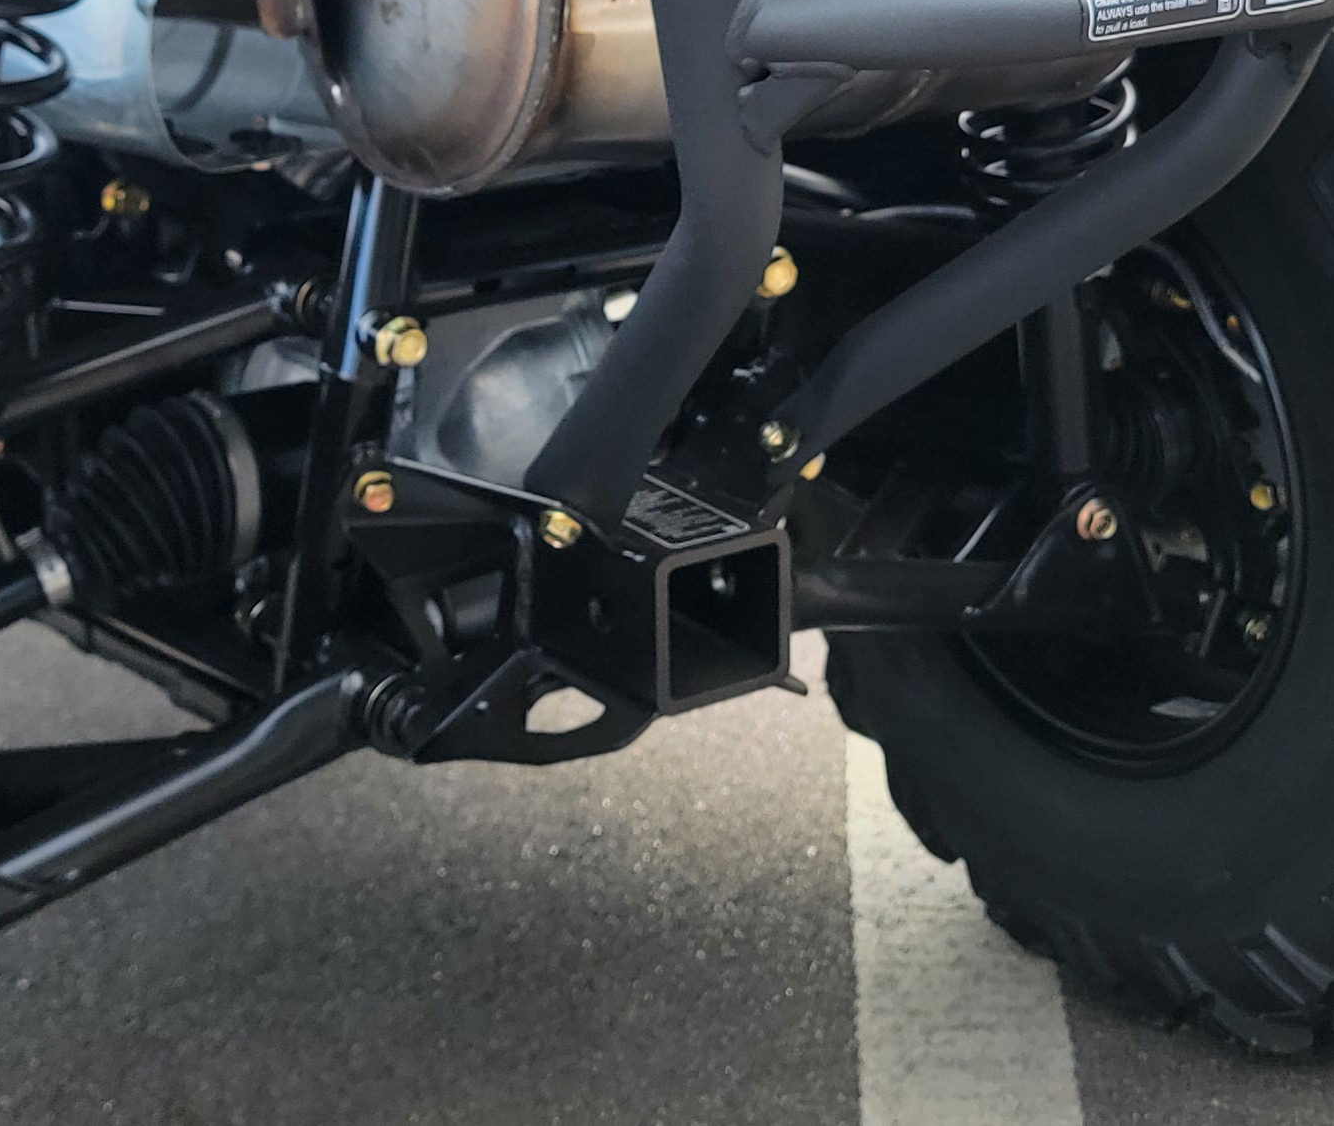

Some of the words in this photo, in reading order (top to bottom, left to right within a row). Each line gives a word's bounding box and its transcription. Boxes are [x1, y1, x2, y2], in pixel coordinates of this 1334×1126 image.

[1096, 4, 1134, 22] ALWAYS
[1134, 4, 1150, 16] use
[1150, 1, 1165, 13] the
[1094, 24, 1105, 35] to
[1104, 20, 1122, 34] pull
